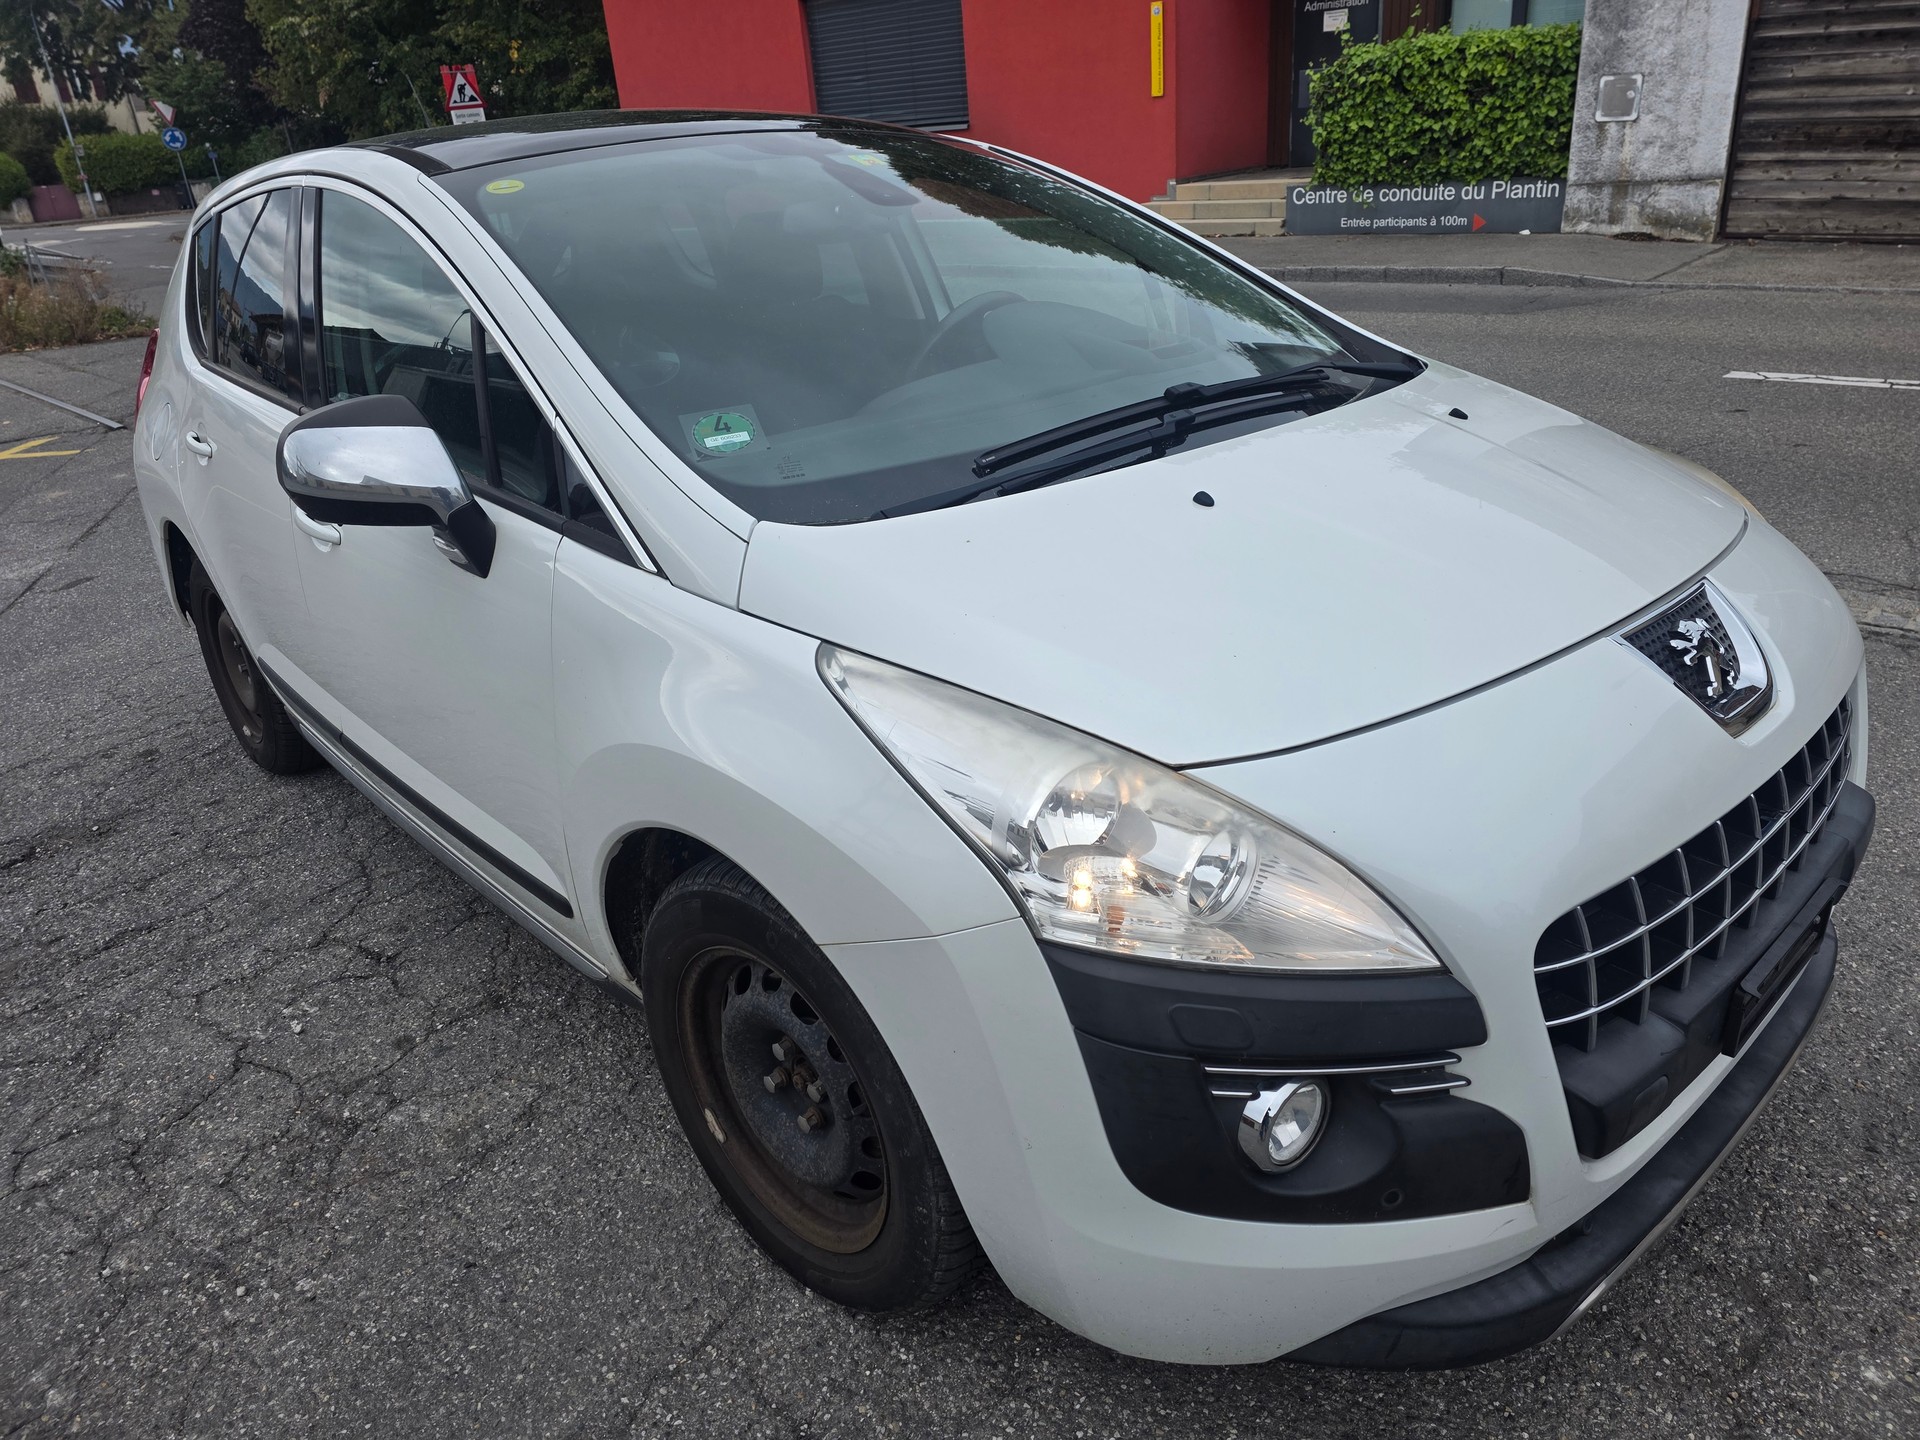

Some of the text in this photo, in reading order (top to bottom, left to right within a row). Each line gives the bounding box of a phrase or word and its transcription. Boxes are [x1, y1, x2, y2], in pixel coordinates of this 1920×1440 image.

[1292, 187, 1348, 205] Centre
[1379, 183, 1456, 202] conduite
[1461, 183, 1485, 200] du
[1491, 180, 1560, 199] Plantin
[1340, 215, 1467, 229] Entrée participants à 100m
[714, 415, 732, 432] 4
